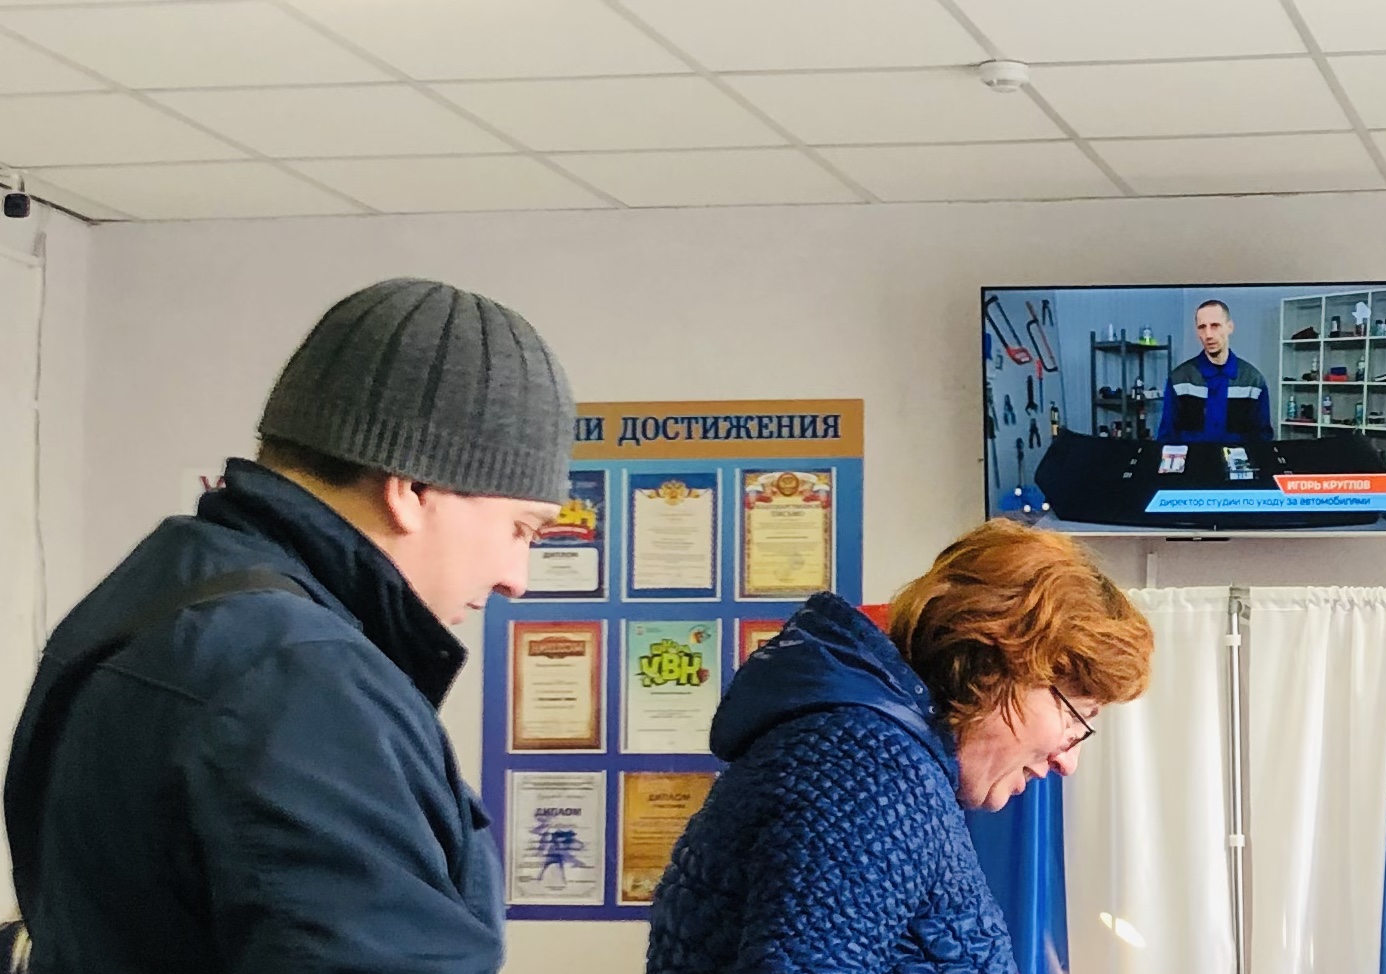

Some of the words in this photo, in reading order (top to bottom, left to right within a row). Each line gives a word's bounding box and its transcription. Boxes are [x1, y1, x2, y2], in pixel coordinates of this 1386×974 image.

[617, 414, 841, 447] ДОСТИЖЕНИЯ
[1286, 480, 1322, 491] ИГОРЬ
[1322, 480, 1371, 490] КРУГЛОВ
[1286, 498, 1298, 506] за
